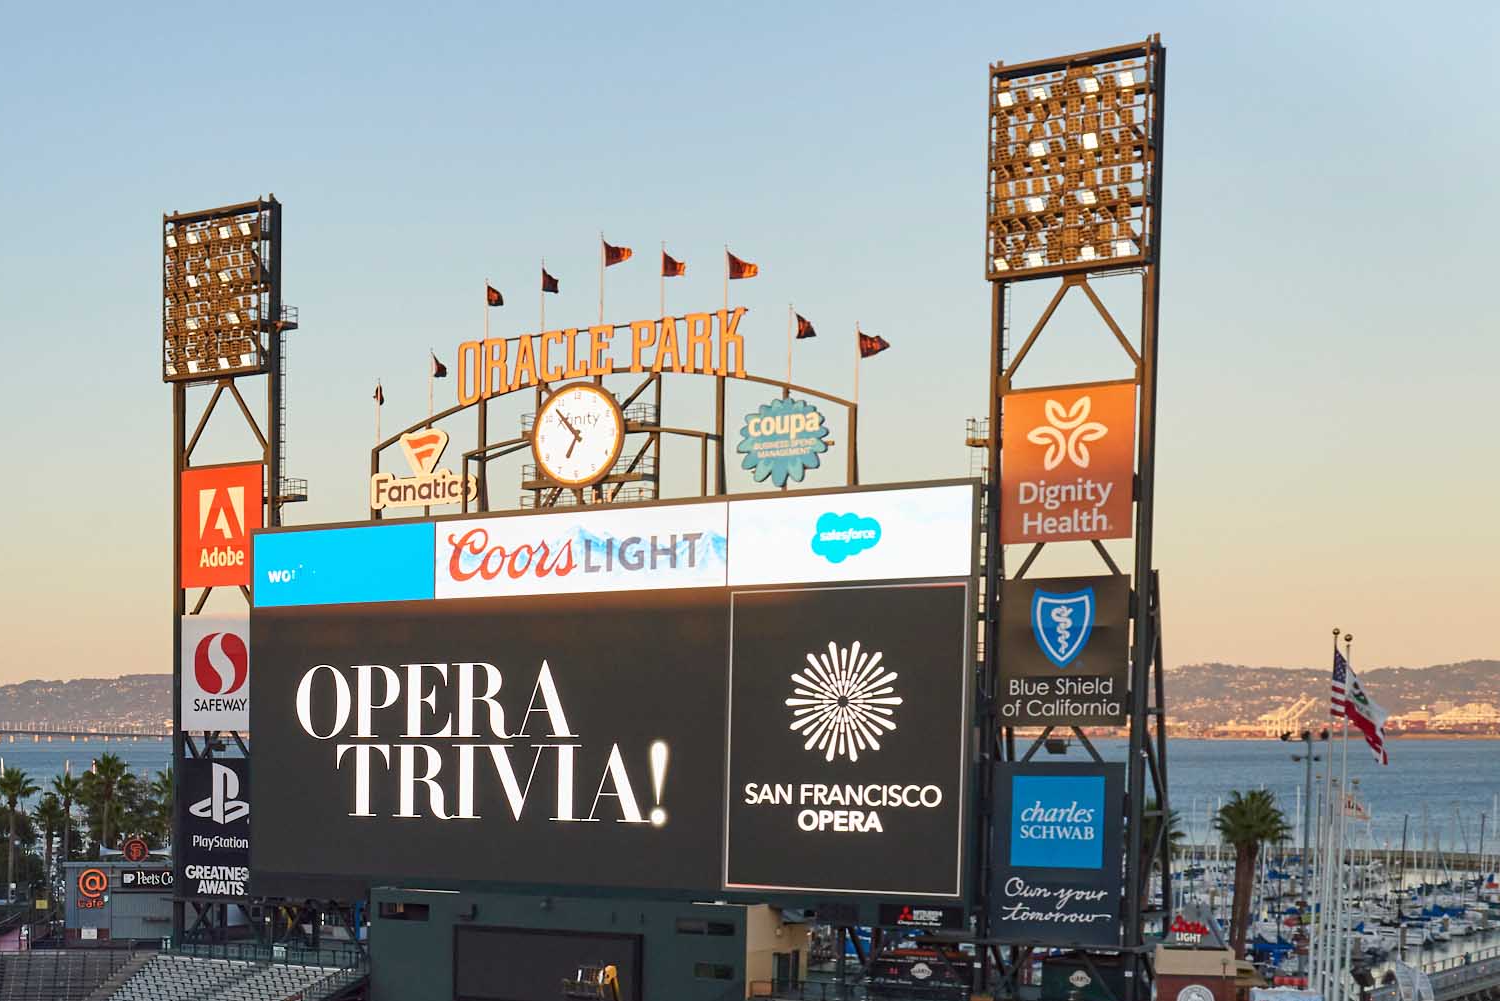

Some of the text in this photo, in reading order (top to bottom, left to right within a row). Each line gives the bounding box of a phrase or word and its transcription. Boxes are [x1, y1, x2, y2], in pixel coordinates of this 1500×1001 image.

[457, 307, 748, 406] ORACLE PARK
[748, 411, 820, 440] coupa
[376, 474, 472, 504] Fanatics
[1018, 479, 1113, 512] Dignity
[1023, 507, 1108, 537] Health
[820, 528, 876, 543] salesforce
[199, 547, 245, 568] Adobe
[448, 528, 703, 583] Coors LIGHT
[1009, 677, 1114, 696] Blue Shield
[194, 699, 247, 712] SAFEWAY
[296, 659, 579, 739] OPERA
[1002, 698, 1120, 717] of California
[336, 740, 670, 828] TRIVIA!
[744, 783, 943, 808] SAN FRANCISCO
[797, 810, 884, 833] OPERA
[1020, 801, 1094, 824] charles
[192, 835, 249, 851] PlayStation
[1020, 825, 1094, 841] SCHWAB
[185, 865, 249, 881] GREATNES
[197, 880, 245, 896] AWAITS
[1005, 876, 1108, 911] Own your
[1002, 902, 1112, 924] tomorrow
[1171, 914, 1210, 936] Coors
[1176, 932, 1202, 943] LIGHT
